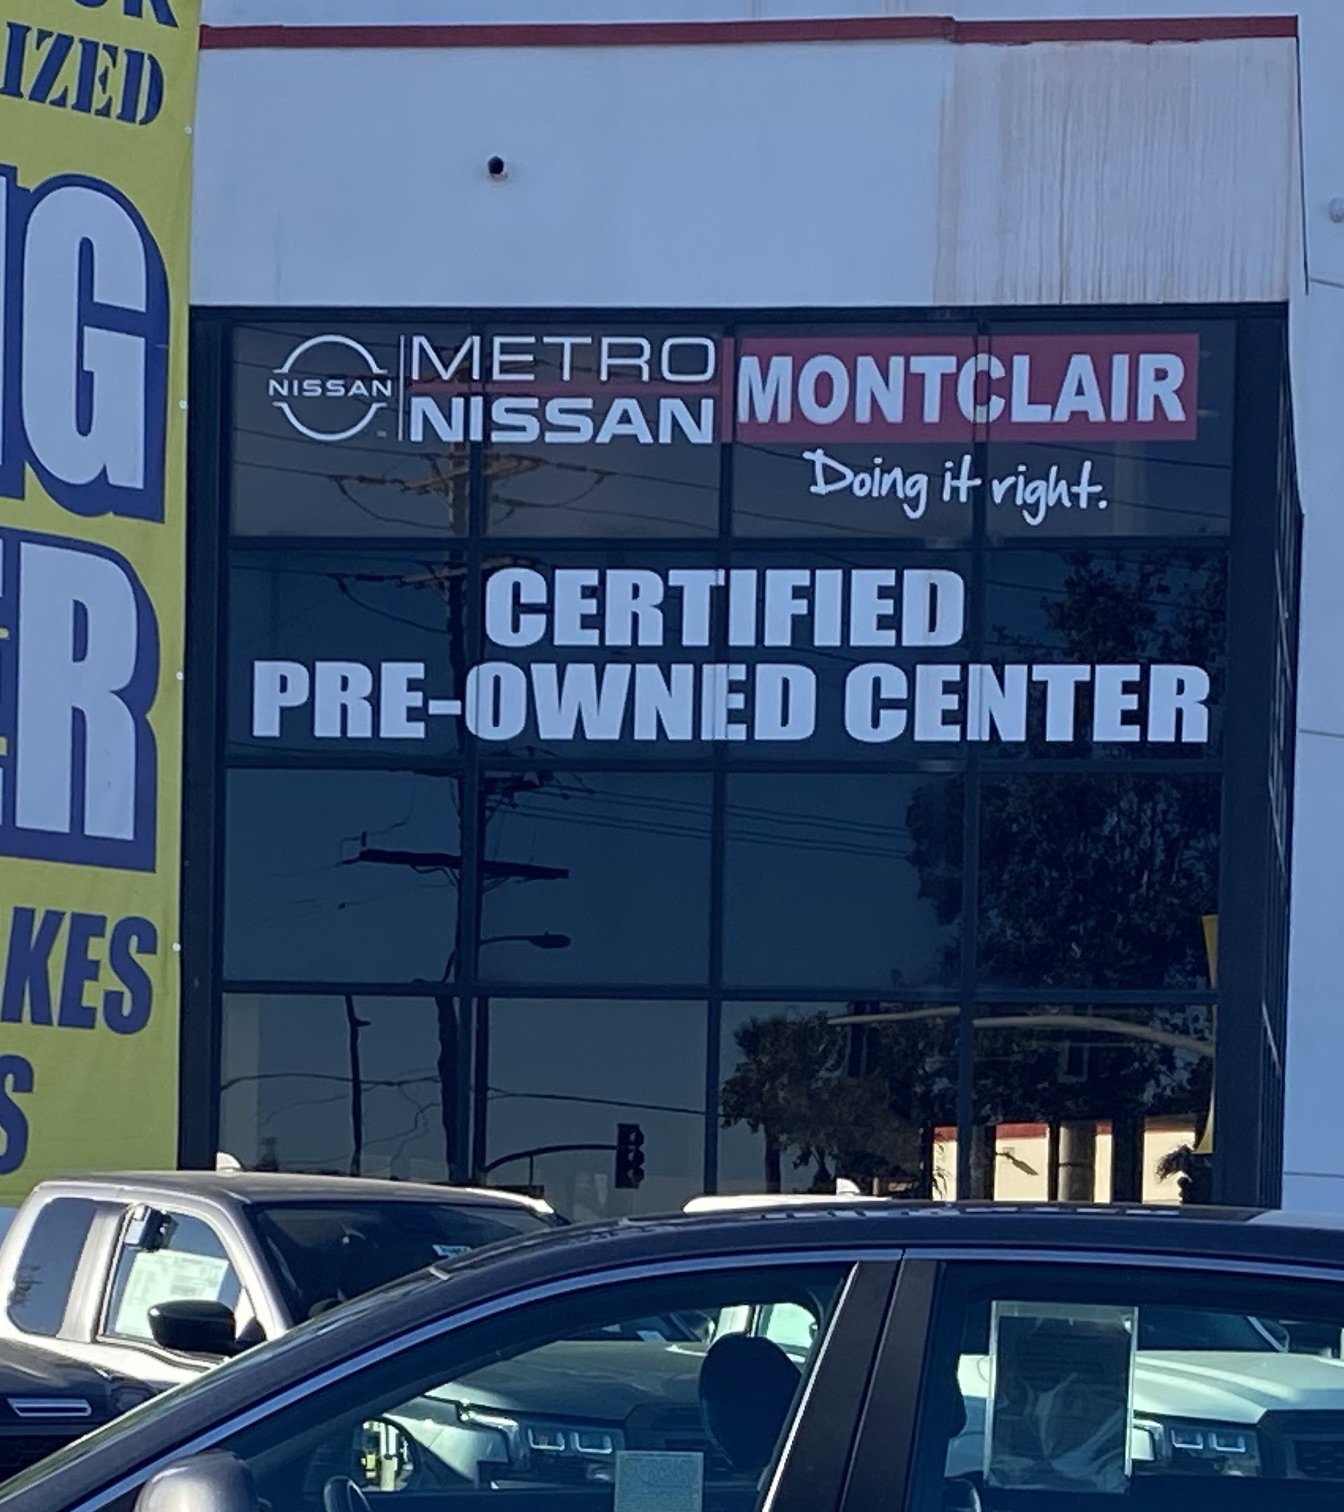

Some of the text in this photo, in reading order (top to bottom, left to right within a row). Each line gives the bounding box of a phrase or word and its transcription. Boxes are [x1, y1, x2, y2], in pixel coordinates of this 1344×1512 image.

[268, 378, 393, 398] NISSAN
[411, 334, 716, 384] METRO
[736, 353, 1187, 425] MONTCLAIR
[409, 396, 714, 444] NISSAN
[803, 448, 1109, 526] Doing it right.
[484, 567, 965, 648] CERTIFIED
[252, 660, 1211, 743] PRE-OWNED CENTER
